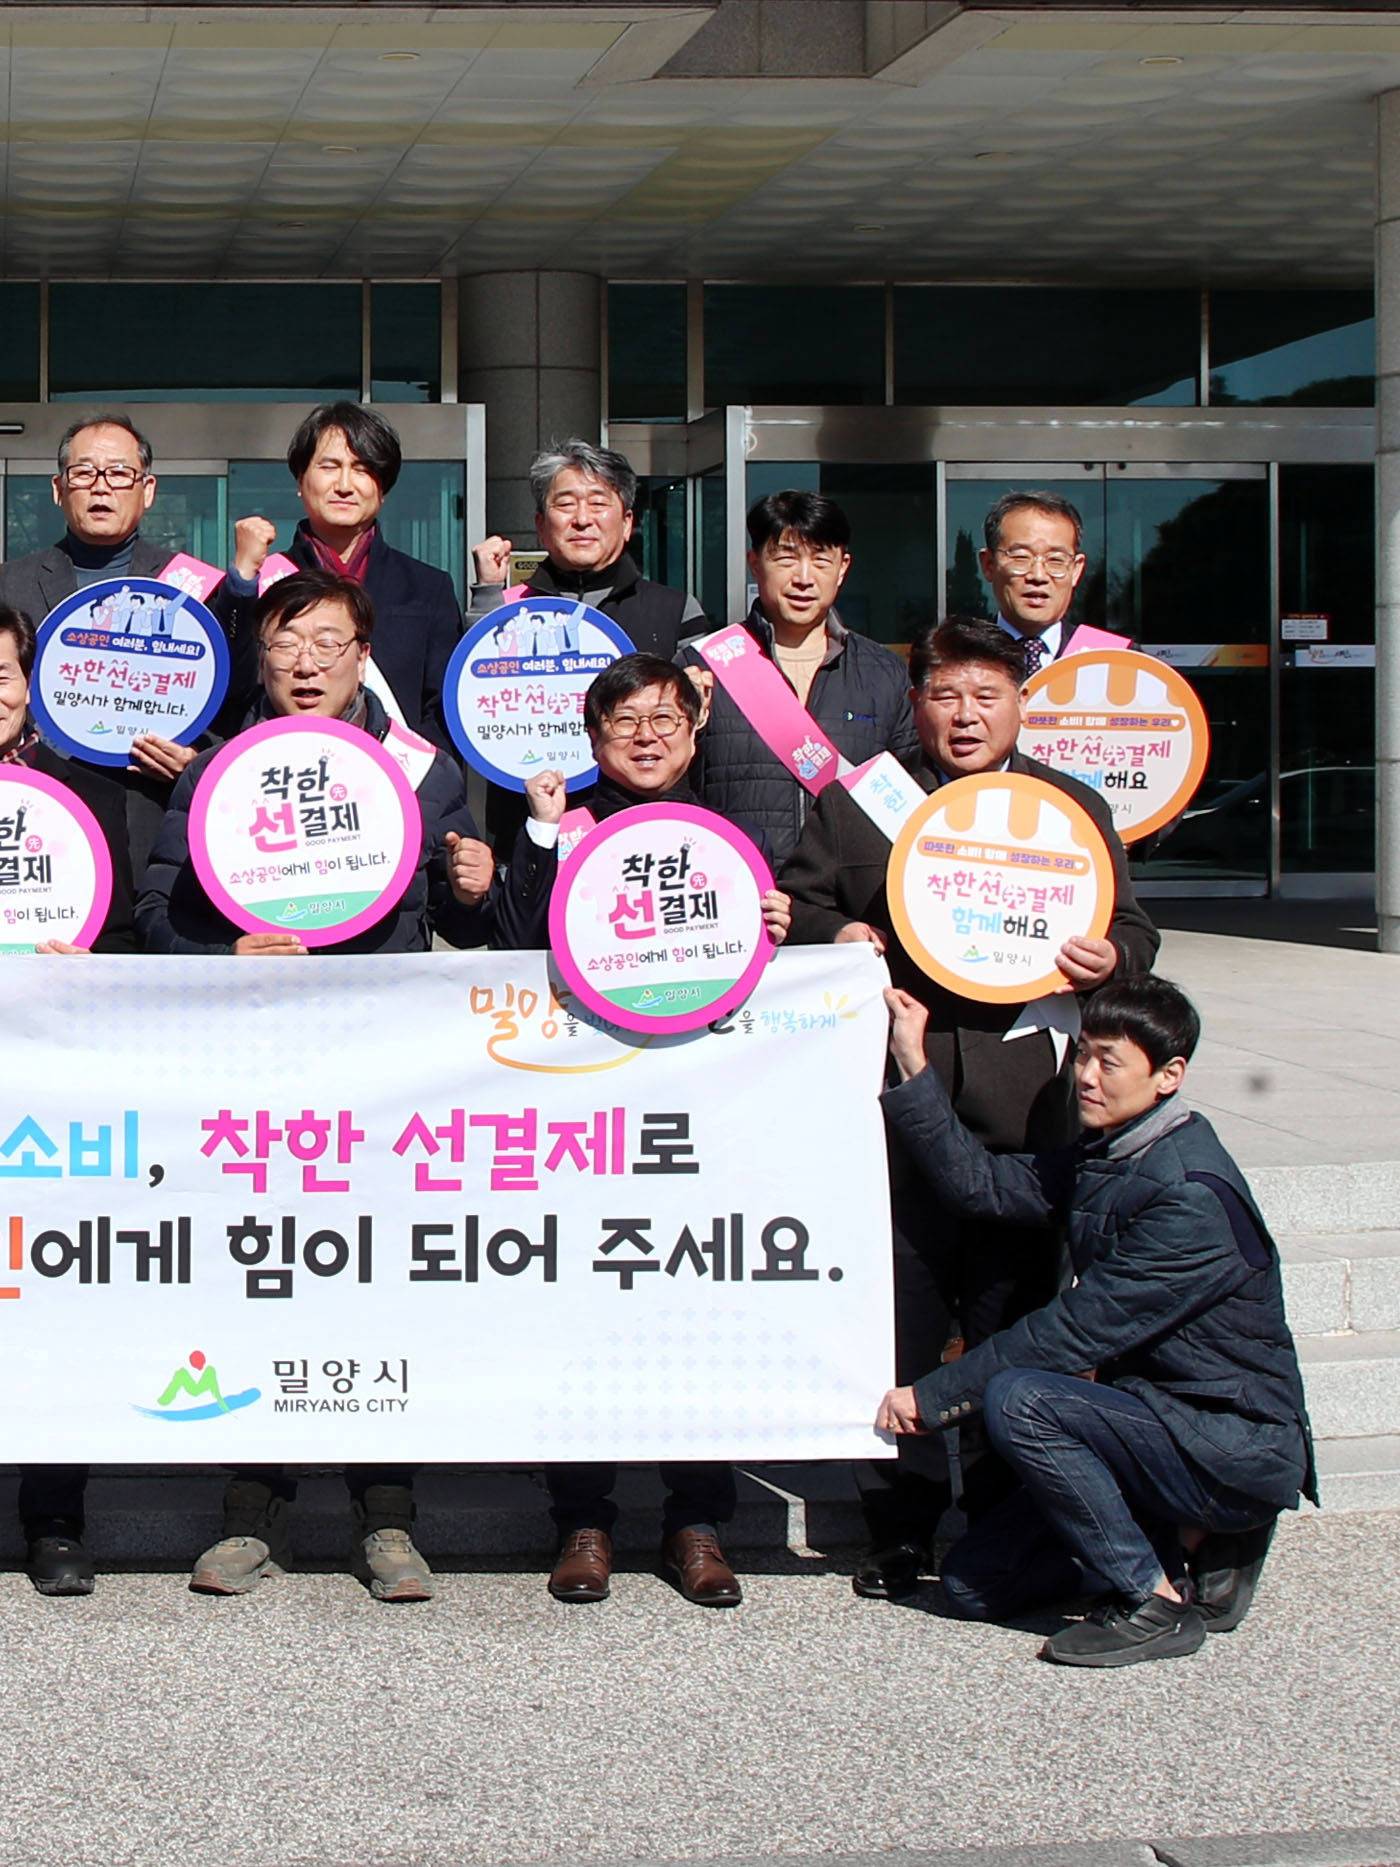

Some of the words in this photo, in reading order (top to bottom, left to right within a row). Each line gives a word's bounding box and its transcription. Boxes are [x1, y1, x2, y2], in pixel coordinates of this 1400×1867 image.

[66, 633, 110, 648] 소상공인
[112, 639, 148, 652] 여러분,
[151, 641, 201, 656] 힘내세요!
[477, 661, 520, 674] 소상공인
[522, 658, 559, 673] 여러분,
[53, 691, 109, 708] 밀양시가
[113, 697, 188, 717] 함께합니다.
[116, 724, 150, 736] 밀양시
[477, 724, 533, 741] 밀양시가
[546, 751, 580, 761] 밀양시
[260, 757, 330, 804] 착한
[1064, 769, 1148, 789] 께해요
[1110, 803, 1132, 815] 양시
[27, 836, 42, 851] 先
[305, 838, 326, 847] GOOD
[327, 834, 362, 844] PAYMENT
[924, 841, 955, 854] 따뜻한
[1010, 852, 1051, 866] 성장하는
[1053, 858, 1075, 869] 우리
[229, 861, 311, 885] 소상공인에게
[314, 858, 342, 876] 힘이
[345, 851, 391, 871] 됩니다.
[621, 844, 691, 889] 착한
[18, 886, 52, 895] PAYMENT
[3, 907, 30, 924] 힘이
[34, 906, 79, 923] 됩니다.
[308, 900, 346, 914] 밀양시
[663, 926, 684, 935] GOOD
[685, 923, 719, 932] PAYMENT
[952, 906, 1050, 940] 함께해요
[587, 949, 668, 972] 소상공인에게
[672, 945, 698, 963] 힘이
[702, 940, 747, 960] 됩니다.
[993, 952, 1032, 967] 밀양시
[665, 987, 701, 1001] 밀양시
[761, 1008, 837, 1031] 행복하게
[200, 1108, 365, 1194] 착한
[393, 1107, 700, 1192] 선결제로
[226, 1215, 373, 1299] 힘이
[409, 1214, 558, 1284] 되어
[592, 1213, 845, 1290] 주세요.
[271, 1358, 409, 1395] 밀양시
[273, 1398, 362, 1414] MIRYANG
[366, 1398, 409, 1414] CITY
